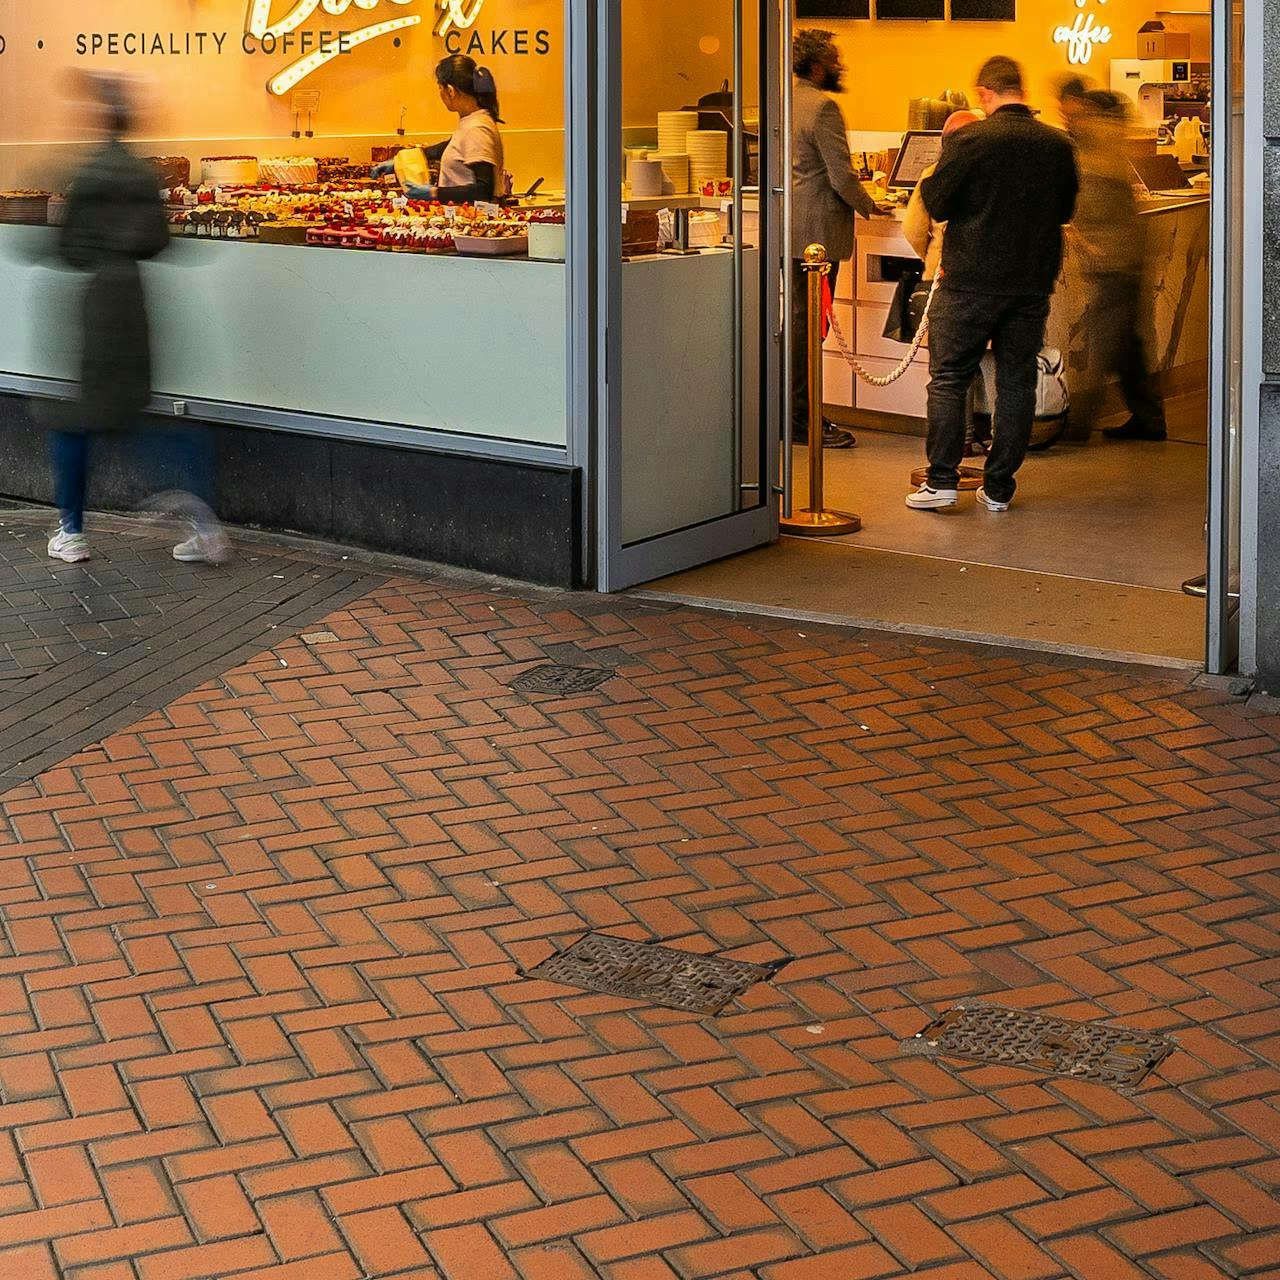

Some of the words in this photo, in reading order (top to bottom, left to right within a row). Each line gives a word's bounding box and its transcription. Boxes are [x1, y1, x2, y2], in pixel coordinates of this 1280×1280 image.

[75, 31, 228, 56] SPECIALITY
[241, 31, 353, 55] COFFEE
[445, 29, 551, 55] CAKES
[1053, 13, 1112, 65] coffee
